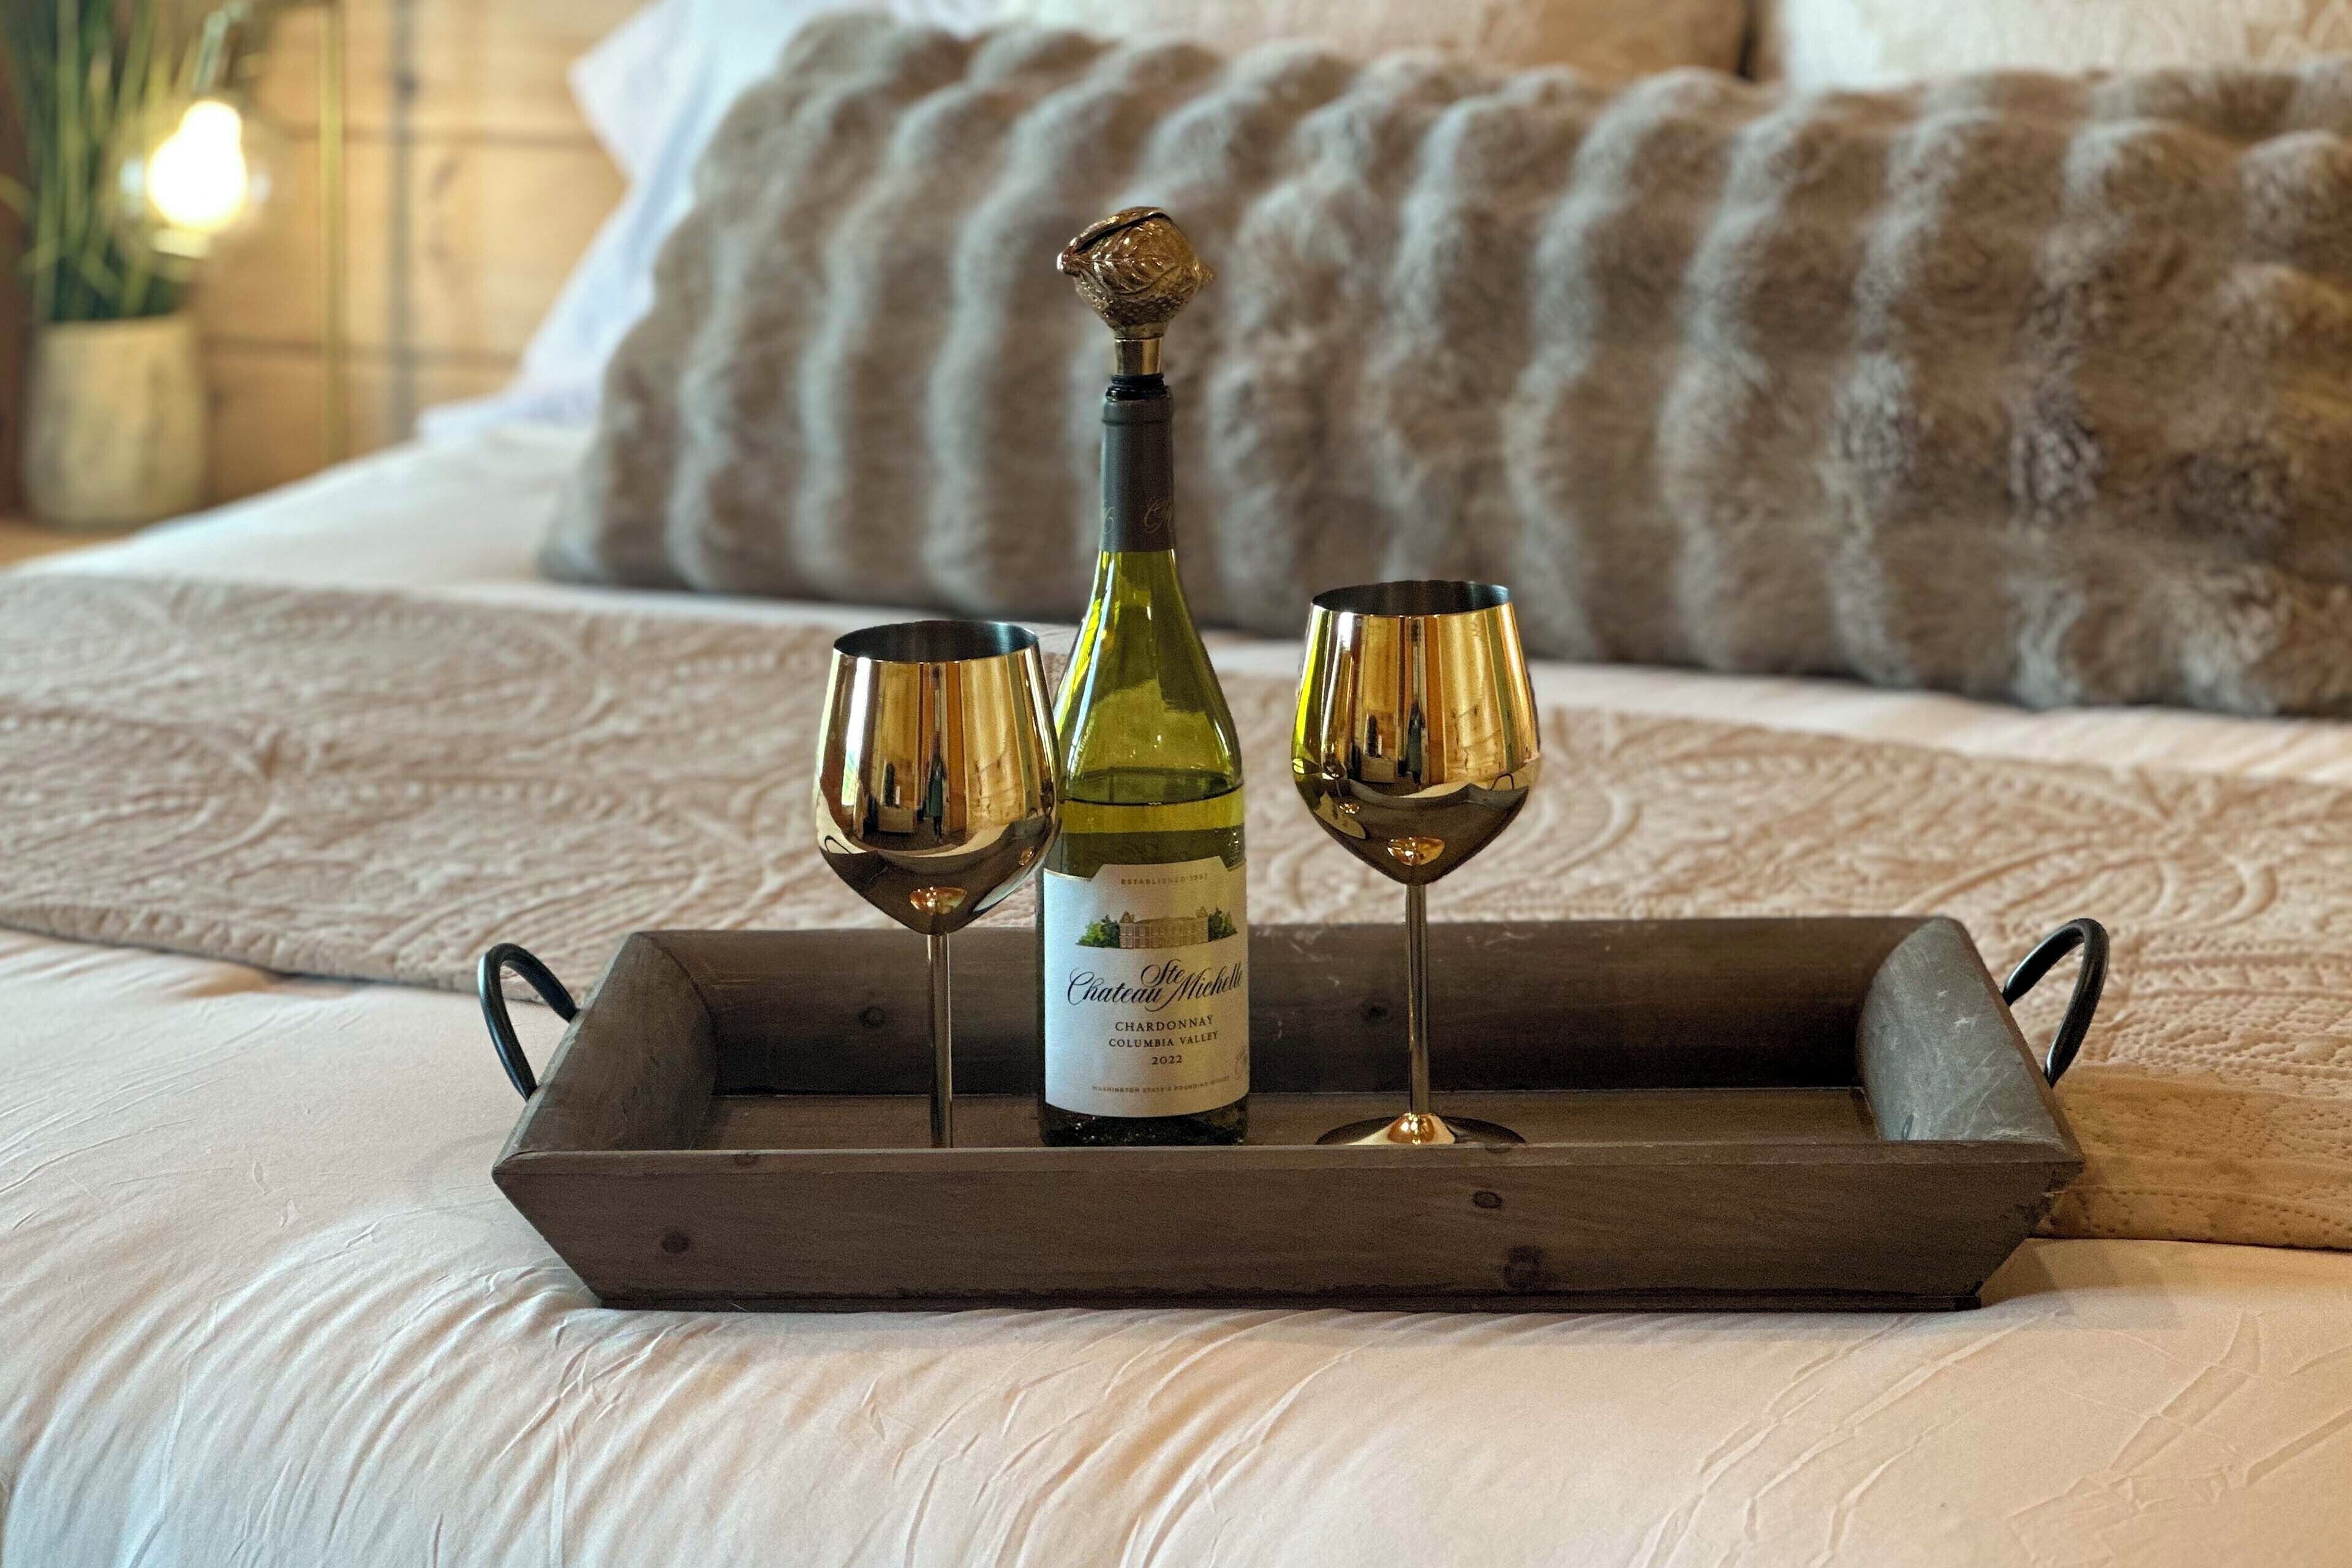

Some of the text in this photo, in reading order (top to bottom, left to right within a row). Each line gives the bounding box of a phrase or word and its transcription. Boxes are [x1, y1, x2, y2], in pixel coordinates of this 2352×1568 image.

[1067, 967, 1165, 1006] Chateau
[1140, 958, 1187, 988] Ste
[1115, 1014, 1215, 1032] CHARDONNAY
[1109, 1031, 1219, 1048] COLUMBIA VALLEY
[1151, 1054, 1183, 1065] 2022
